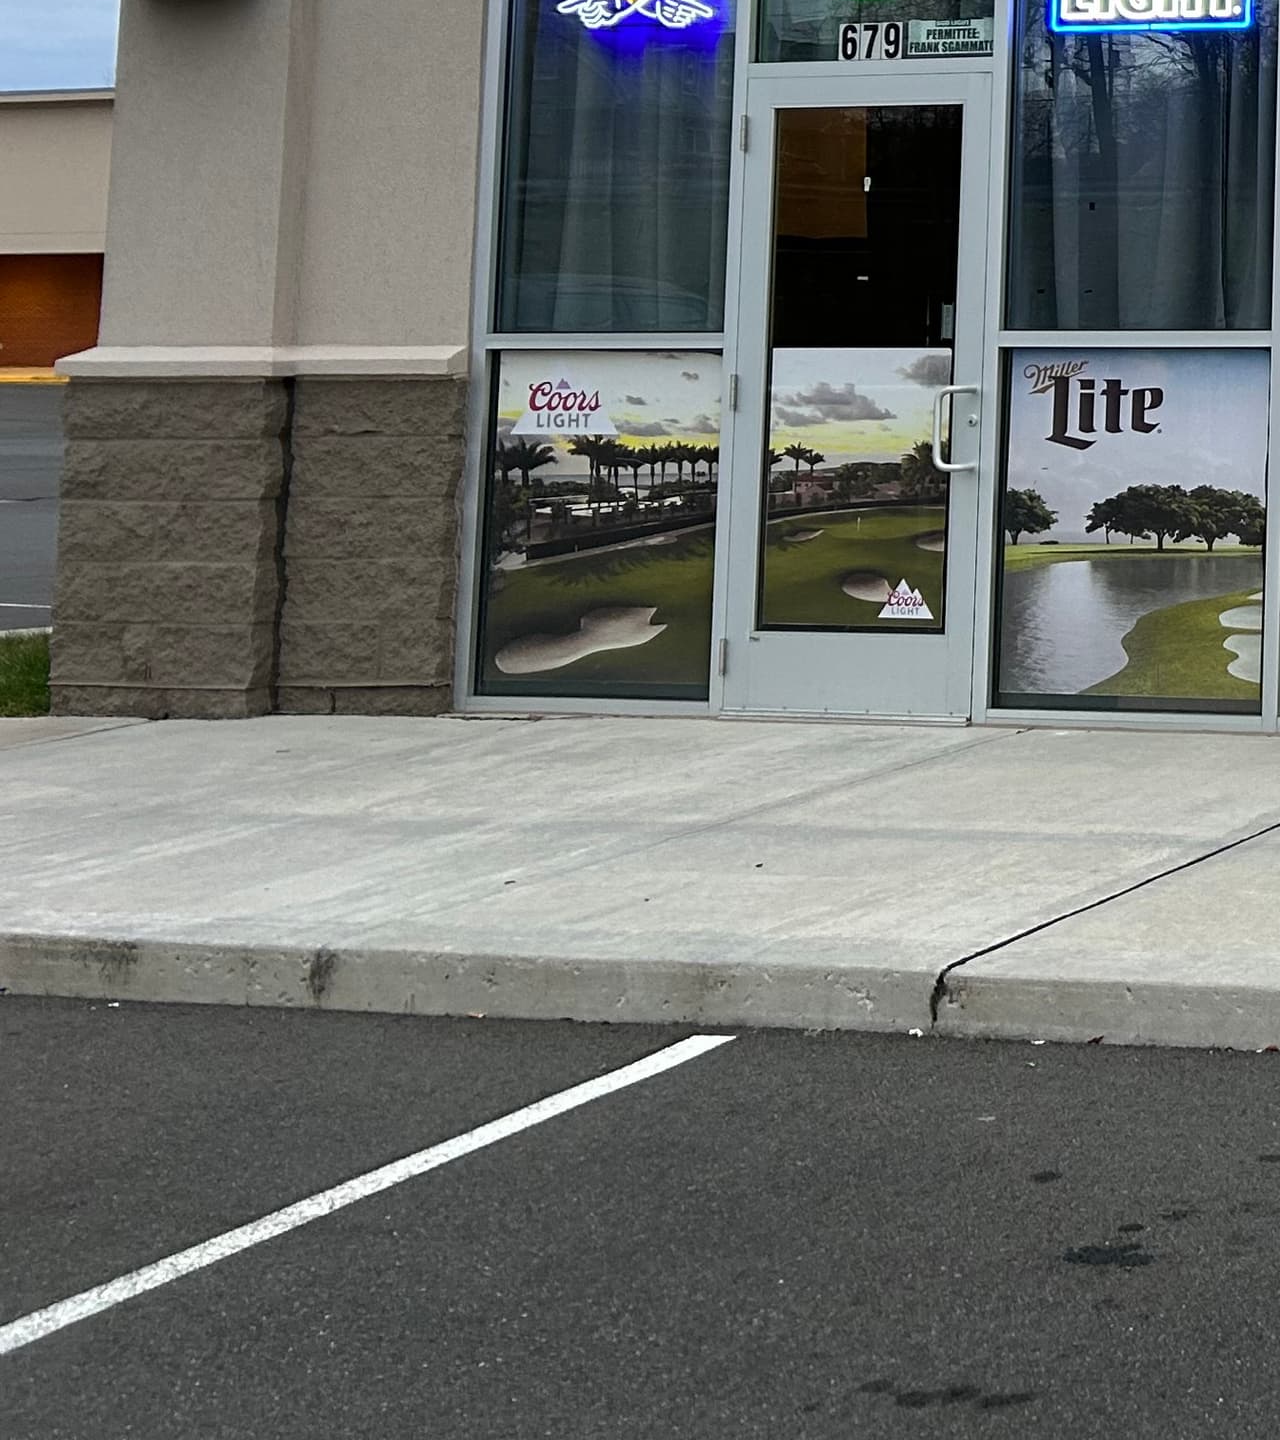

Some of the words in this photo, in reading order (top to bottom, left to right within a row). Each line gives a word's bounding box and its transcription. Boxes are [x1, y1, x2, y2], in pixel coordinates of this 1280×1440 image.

[840, 23, 901, 60] 679
[909, 41, 940, 53] FRANK
[1023, 360, 1090, 392] Miller
[529, 380, 602, 412] Coors
[536, 413, 591, 428] LIGHT
[1044, 376, 1164, 451] Lite
[887, 590, 924, 607] Coors
[891, 606, 920, 616] LIGHT
